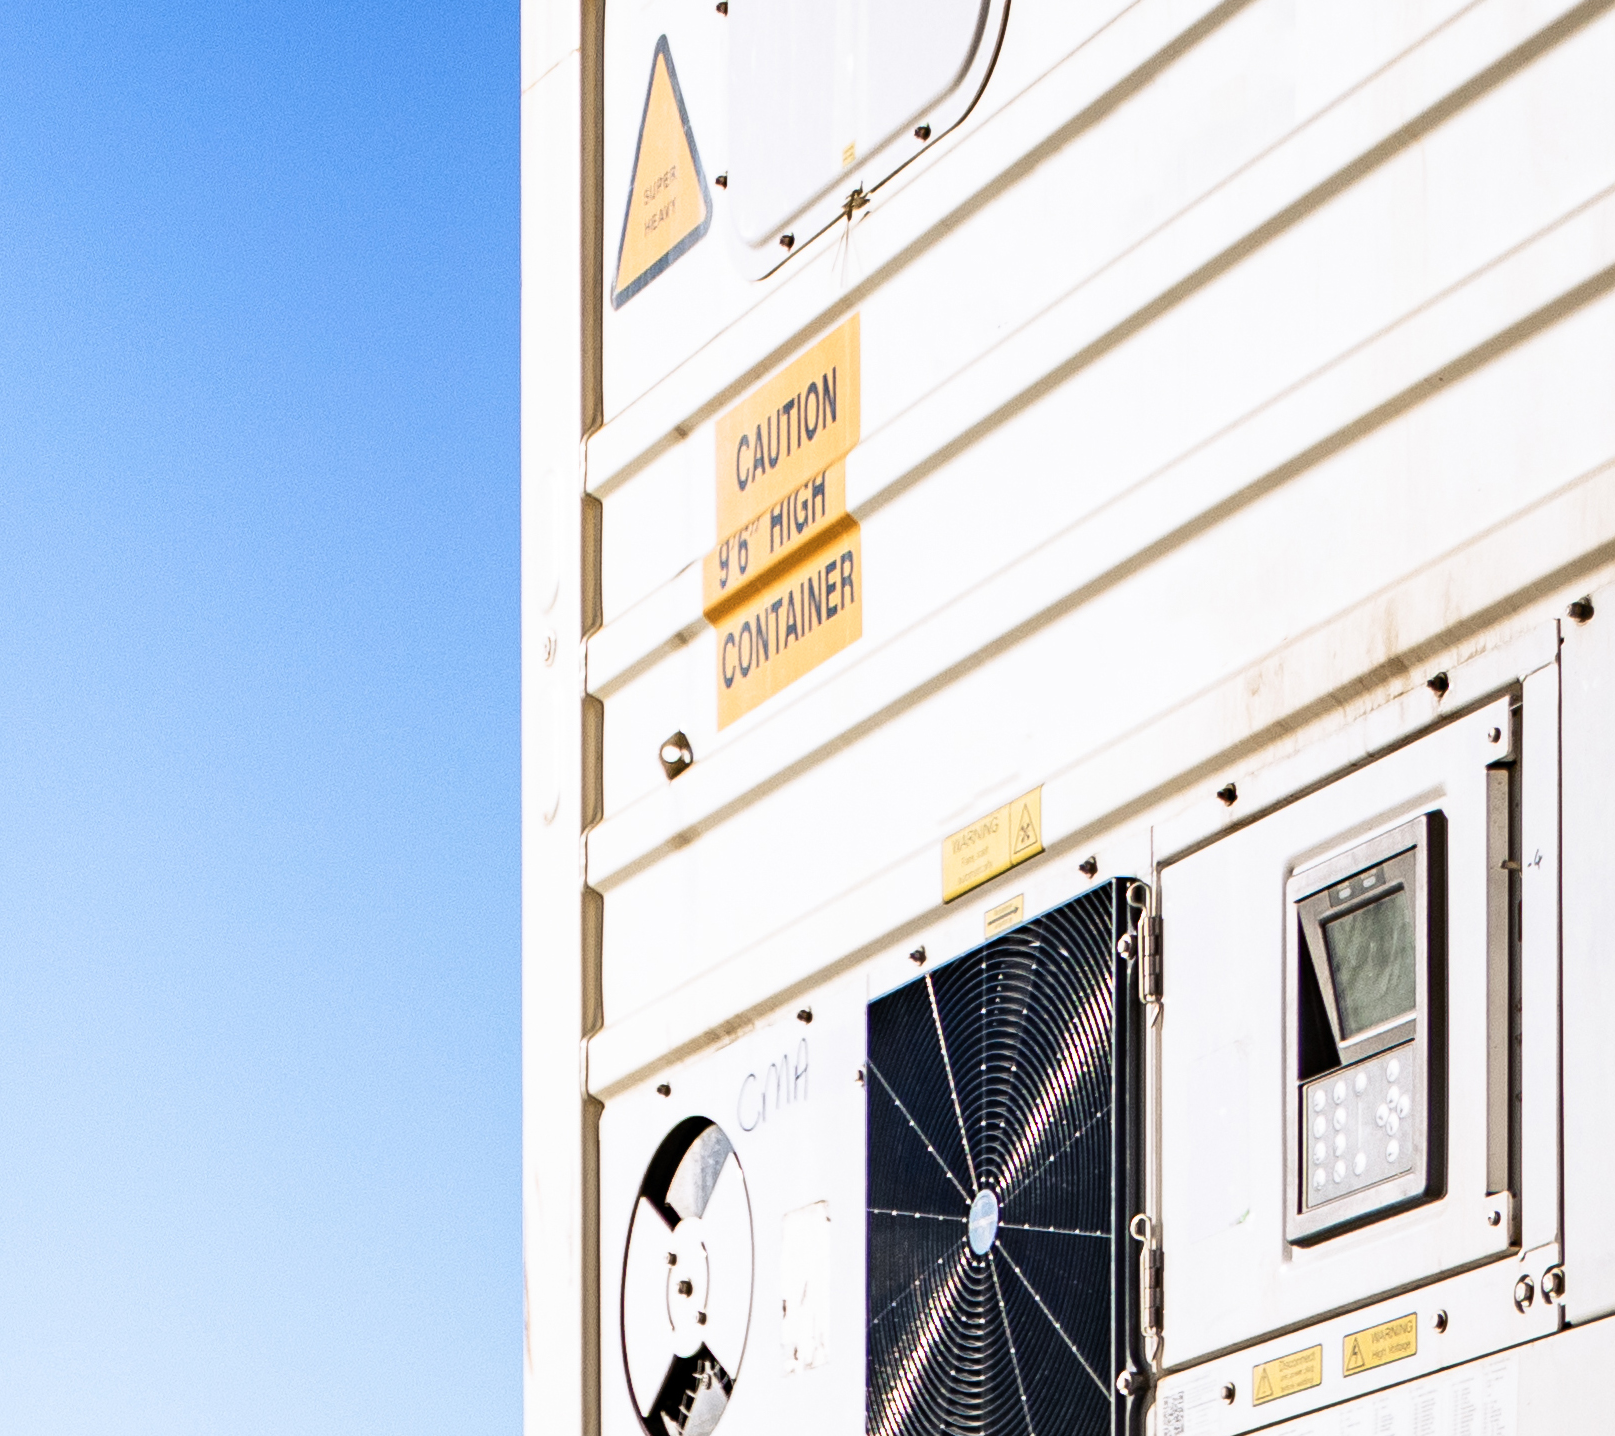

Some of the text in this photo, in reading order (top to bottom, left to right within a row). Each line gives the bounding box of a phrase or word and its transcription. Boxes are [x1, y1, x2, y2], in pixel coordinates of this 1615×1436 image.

[643, 165, 677, 206] SUPER
[644, 197, 678, 237] HEAVY
[736, 366, 837, 492] CAUTION
[769, 468, 827, 554] HIGH
[721, 549, 856, 689] CONTAINER
